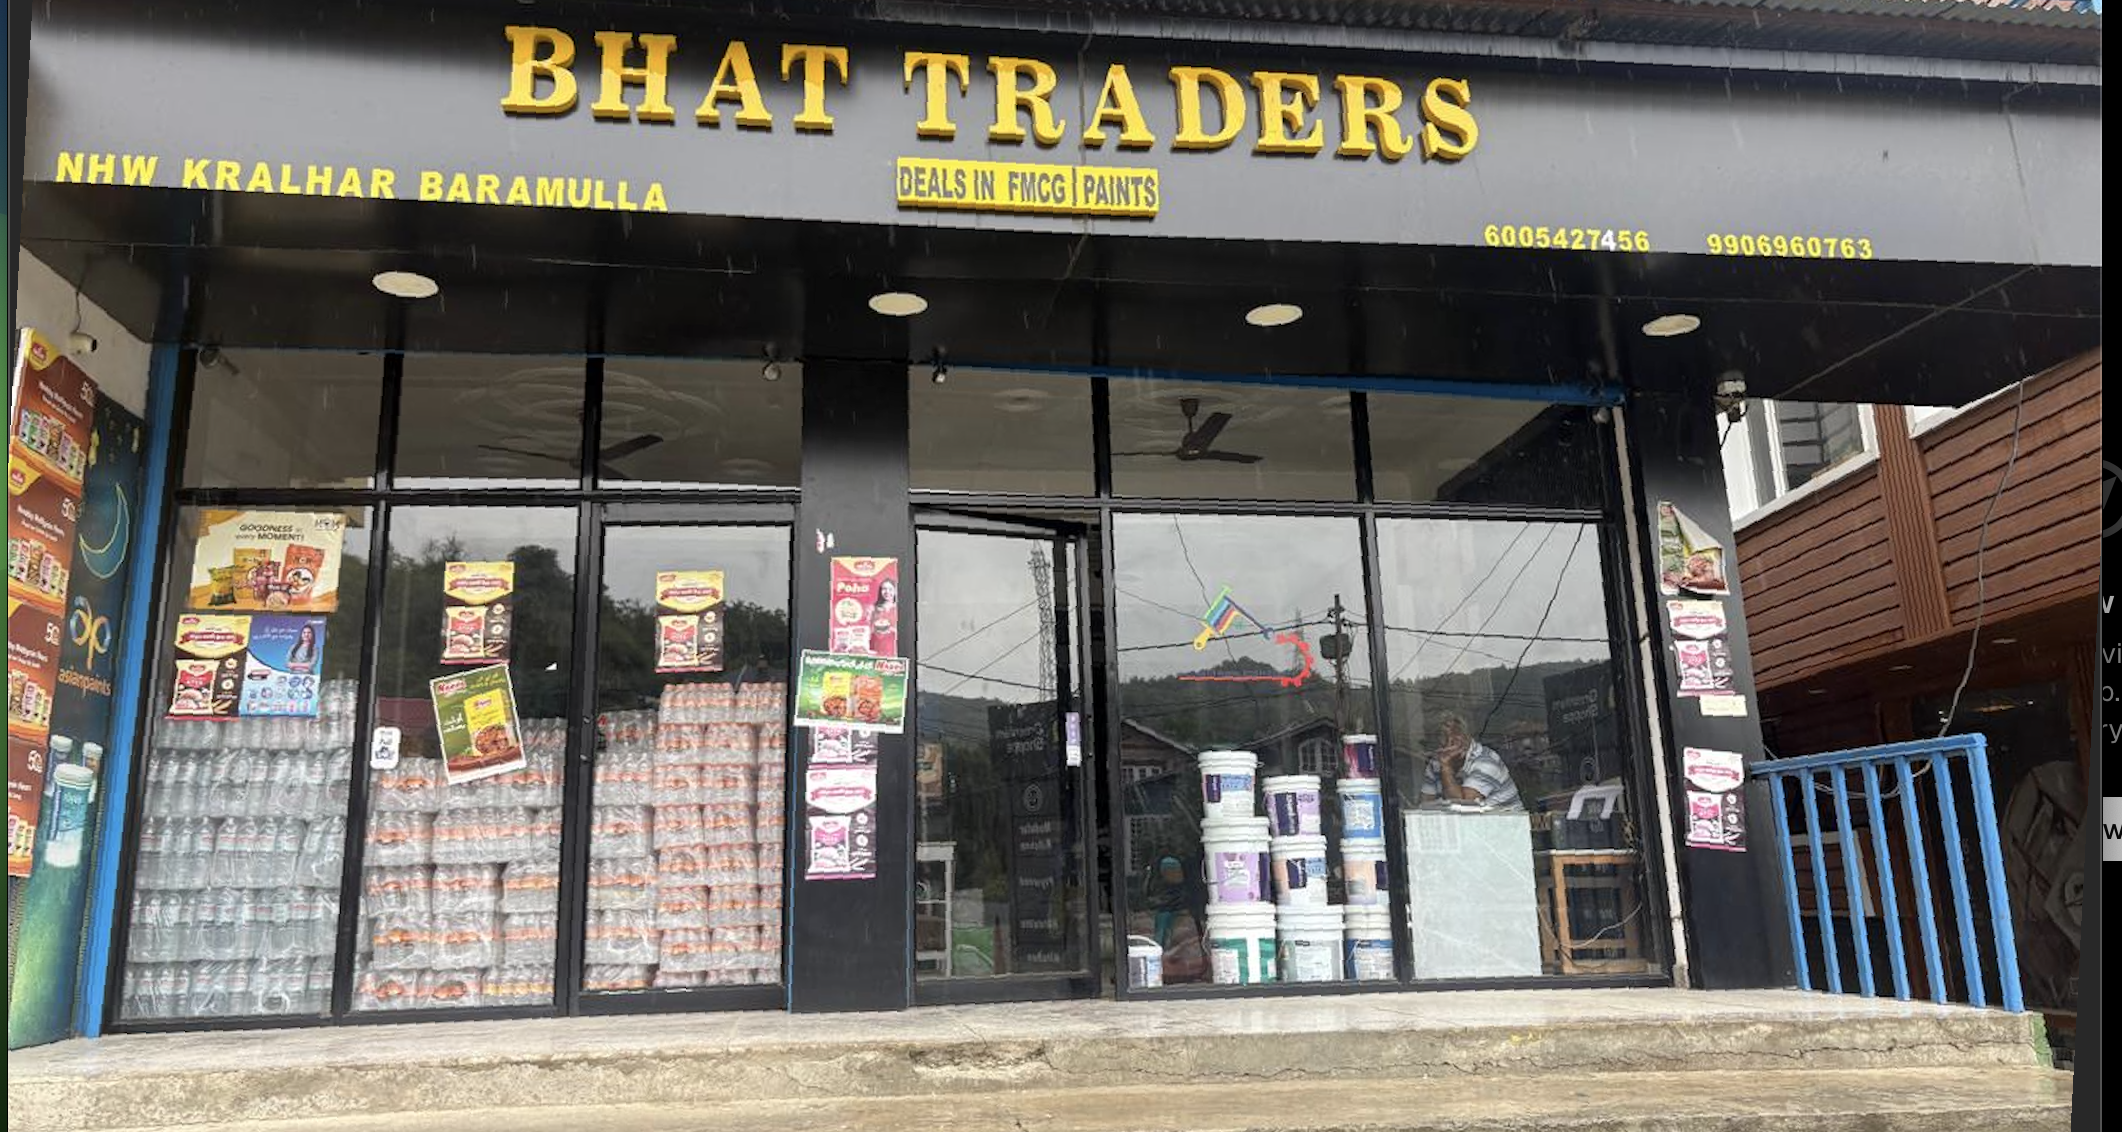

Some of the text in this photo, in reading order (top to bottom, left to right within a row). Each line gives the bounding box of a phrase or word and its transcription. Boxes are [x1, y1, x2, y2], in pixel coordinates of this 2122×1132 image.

[502, 26, 1480, 159] BHAT TRADERS
[56, 152, 668, 213] NHW KRALHAR BARAMULLA
[900, 166, 1157, 207] DEALS IN FMCG PAINTS
[1484, 225, 1650, 253] 6005427456
[1707, 234, 1873, 260] 9906960763
[240, 524, 293, 533] GOODNESS
[836, 581, 871, 594] Poha
